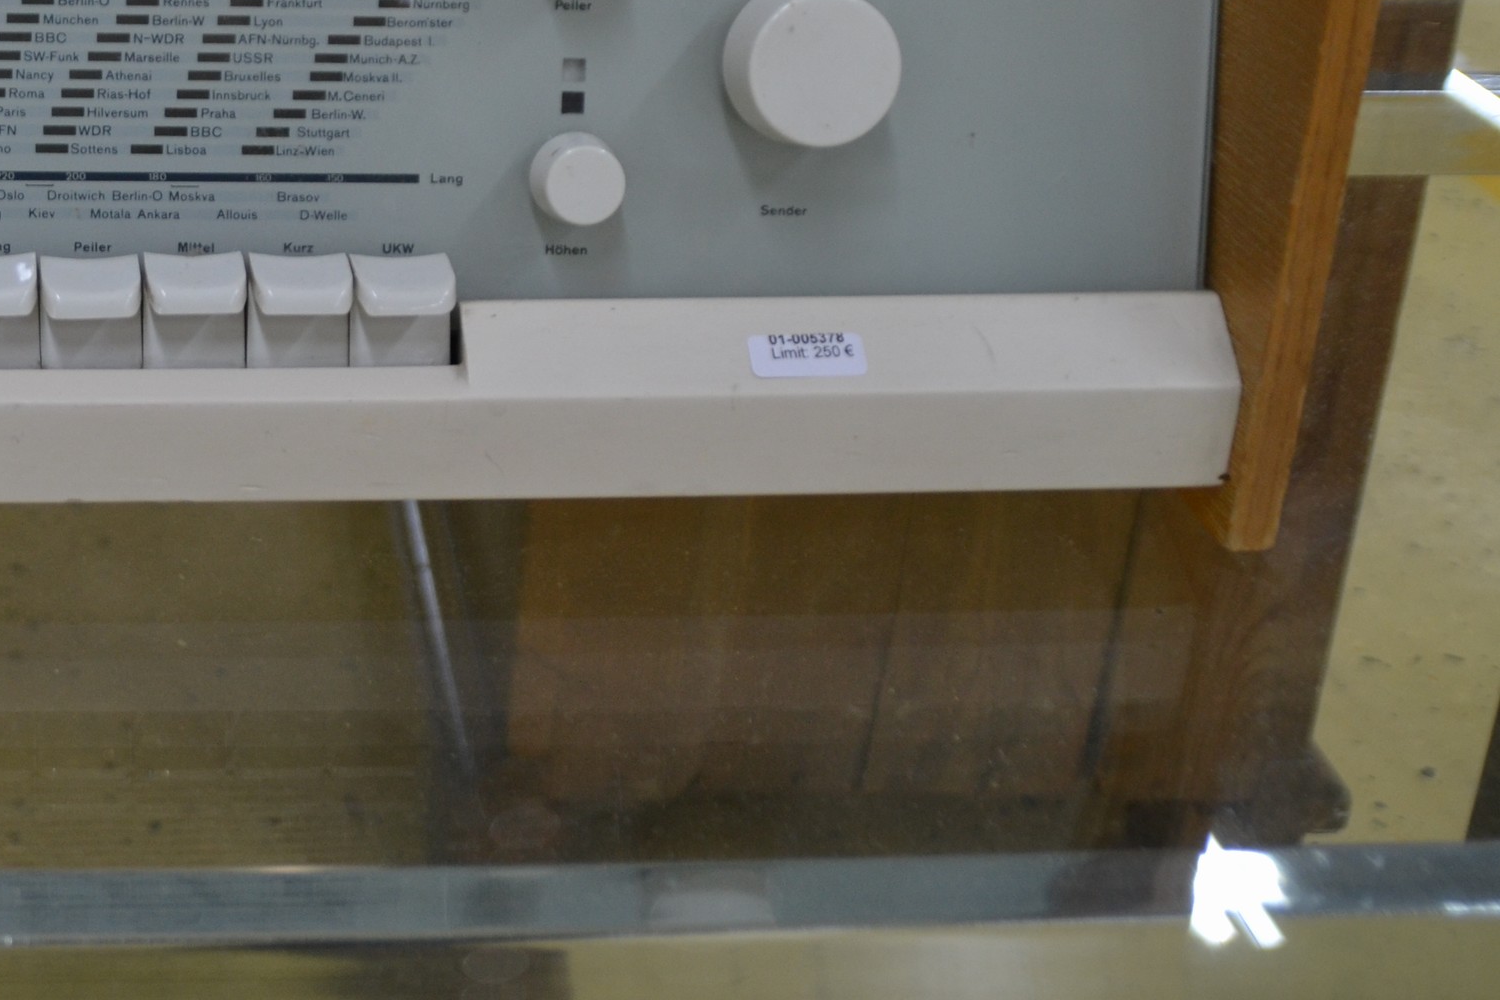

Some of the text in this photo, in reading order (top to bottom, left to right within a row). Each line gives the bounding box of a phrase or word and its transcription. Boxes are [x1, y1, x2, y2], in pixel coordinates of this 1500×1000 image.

[152, 15, 205, 26] Berlin-W
[253, 15, 283, 28] Lyon
[34, 32, 67, 43] BBC
[133, 33, 184, 44] N-WDR
[364, 34, 422, 48] Budapest
[24, 51, 80, 62] SW-Funk
[124, 52, 180, 63] Marseille
[233, 52, 274, 63] USSR
[15, 70, 54, 83] Nancy
[105, 70, 152, 81] Athenai
[224, 71, 282, 82] Bruxelles
[343, 71, 389, 83] Moskva
[8, 88, 45, 99] Roma
[97, 88, 151, 100] Rias-Hof
[212, 89, 271, 101] Innsbruck
[87, 107, 149, 118] Hilversum
[201, 108, 236, 119] Praha
[78, 125, 112, 136] WDR
[190, 126, 222, 137] BBC
[297, 127, 350, 141] Stuttgart
[70, 144, 118, 155] Sottens
[166, 145, 207, 156] Lisboa
[66, 171, 86, 180] 200
[430, 172, 464, 186] Lang
[47, 190, 105, 201] Droitwich
[112, 190, 163, 202] Berlin-O
[169, 191, 215, 202] Moskva
[277, 191, 320, 202] Brasov
[28, 208, 55, 219] Kiev
[90, 208, 131, 220] Motala
[137, 209, 180, 220] Ankara
[216, 209, 258, 220] Allouis
[299, 209, 348, 221] D-Welle
[760, 204, 808, 216] Sender
[283, 242, 314, 253] Kurz
[382, 243, 414, 254] UKW
[545, 244, 588, 256] Höhen
[813, 345, 841, 358] 250
[844, 343, 854, 357] €
